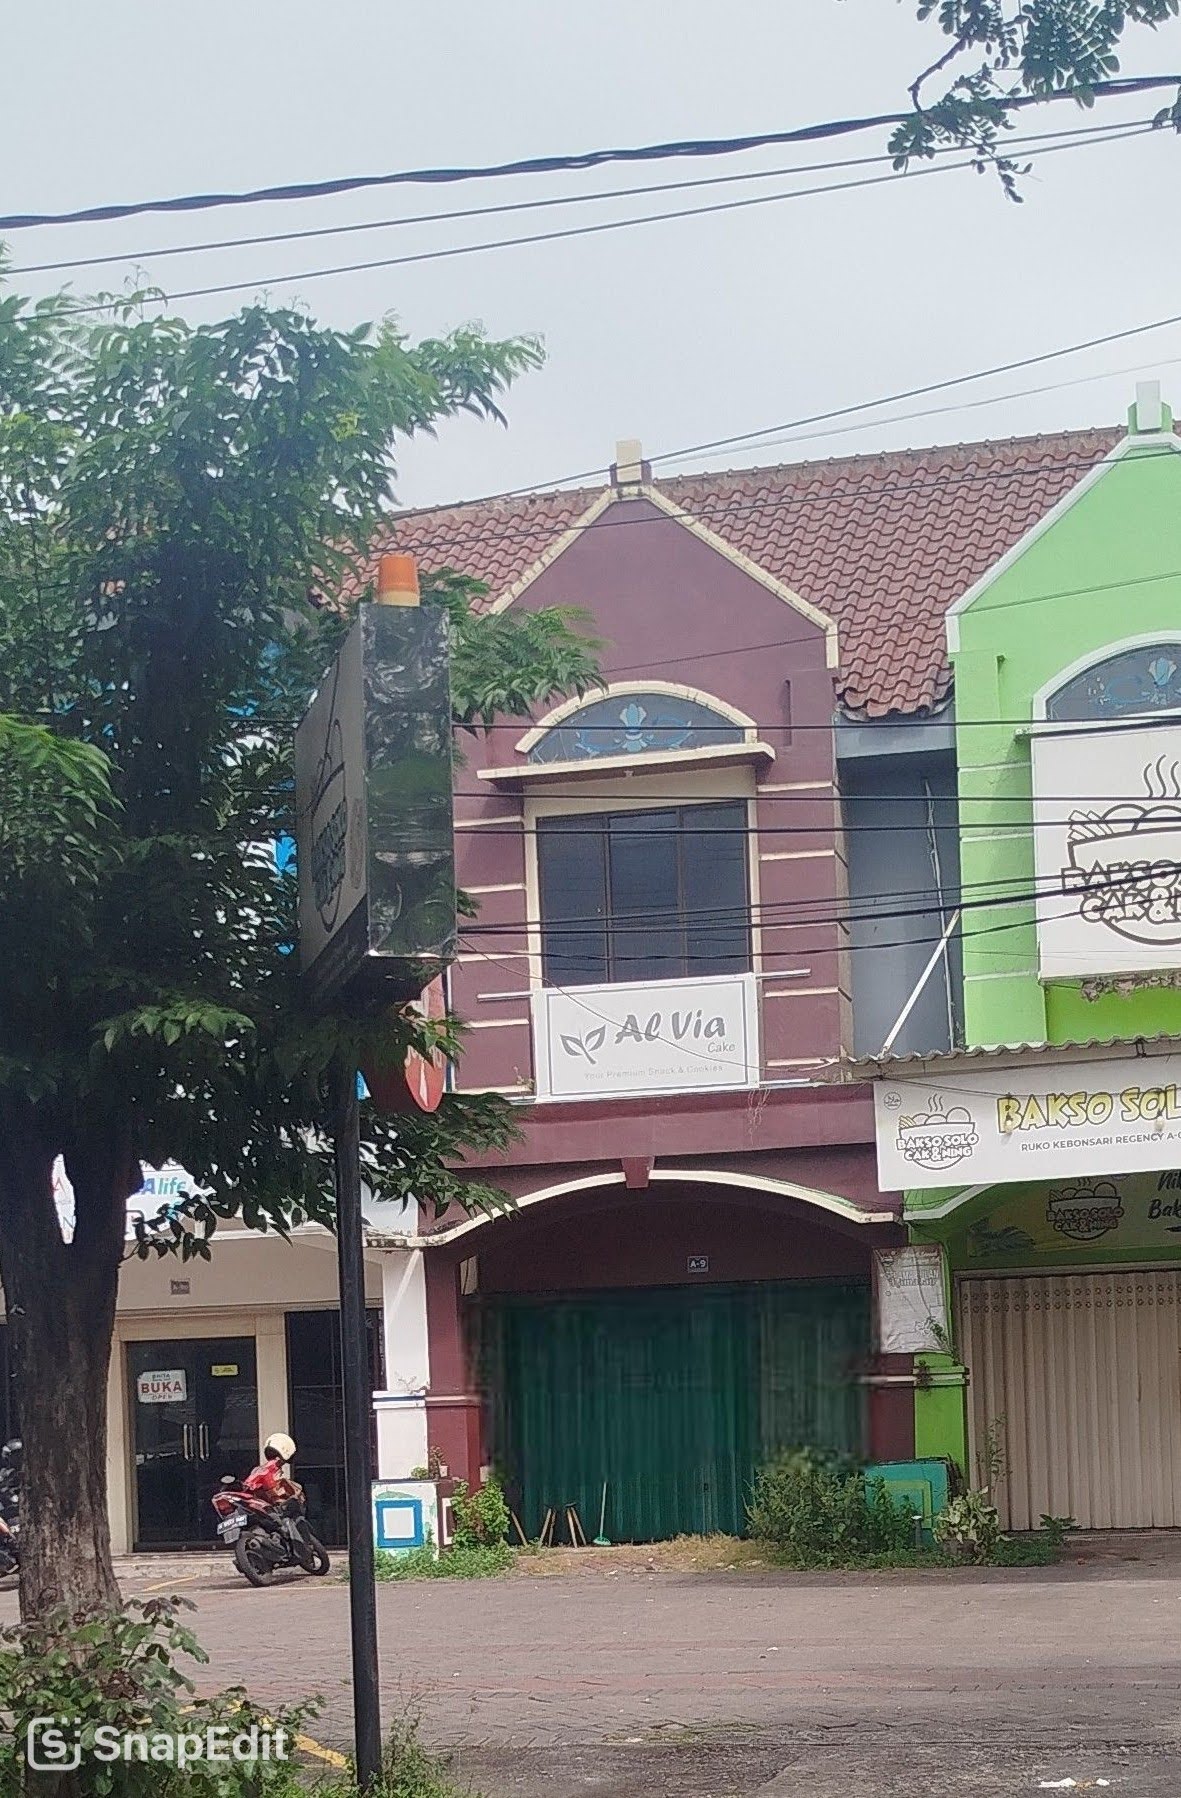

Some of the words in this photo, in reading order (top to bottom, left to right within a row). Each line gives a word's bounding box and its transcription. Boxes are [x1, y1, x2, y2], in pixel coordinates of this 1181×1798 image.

[1080, 889, 1147, 923] CAK
[615, 1012, 661, 1043] Al
[671, 1009, 726, 1040] Via
[707, 1041, 735, 1053] Cake
[606, 1069, 646, 1079] Premium
[687, 1064, 723, 1074] Cookies
[997, 1091, 1113, 1133] BAKSO
[896, 1135, 943, 1150] BAKSO
[943, 1132, 979, 1147] SOLO
[1021, 1141, 1050, 1151] RUKO
[1053, 1136, 1113, 1149] KEBONSARI
[1115, 1132, 1164, 1144] REGENCY
[904, 1148, 931, 1161] CAK
[942, 1146, 973, 1158] NING
[141, 1381, 182, 1393] BUKA
